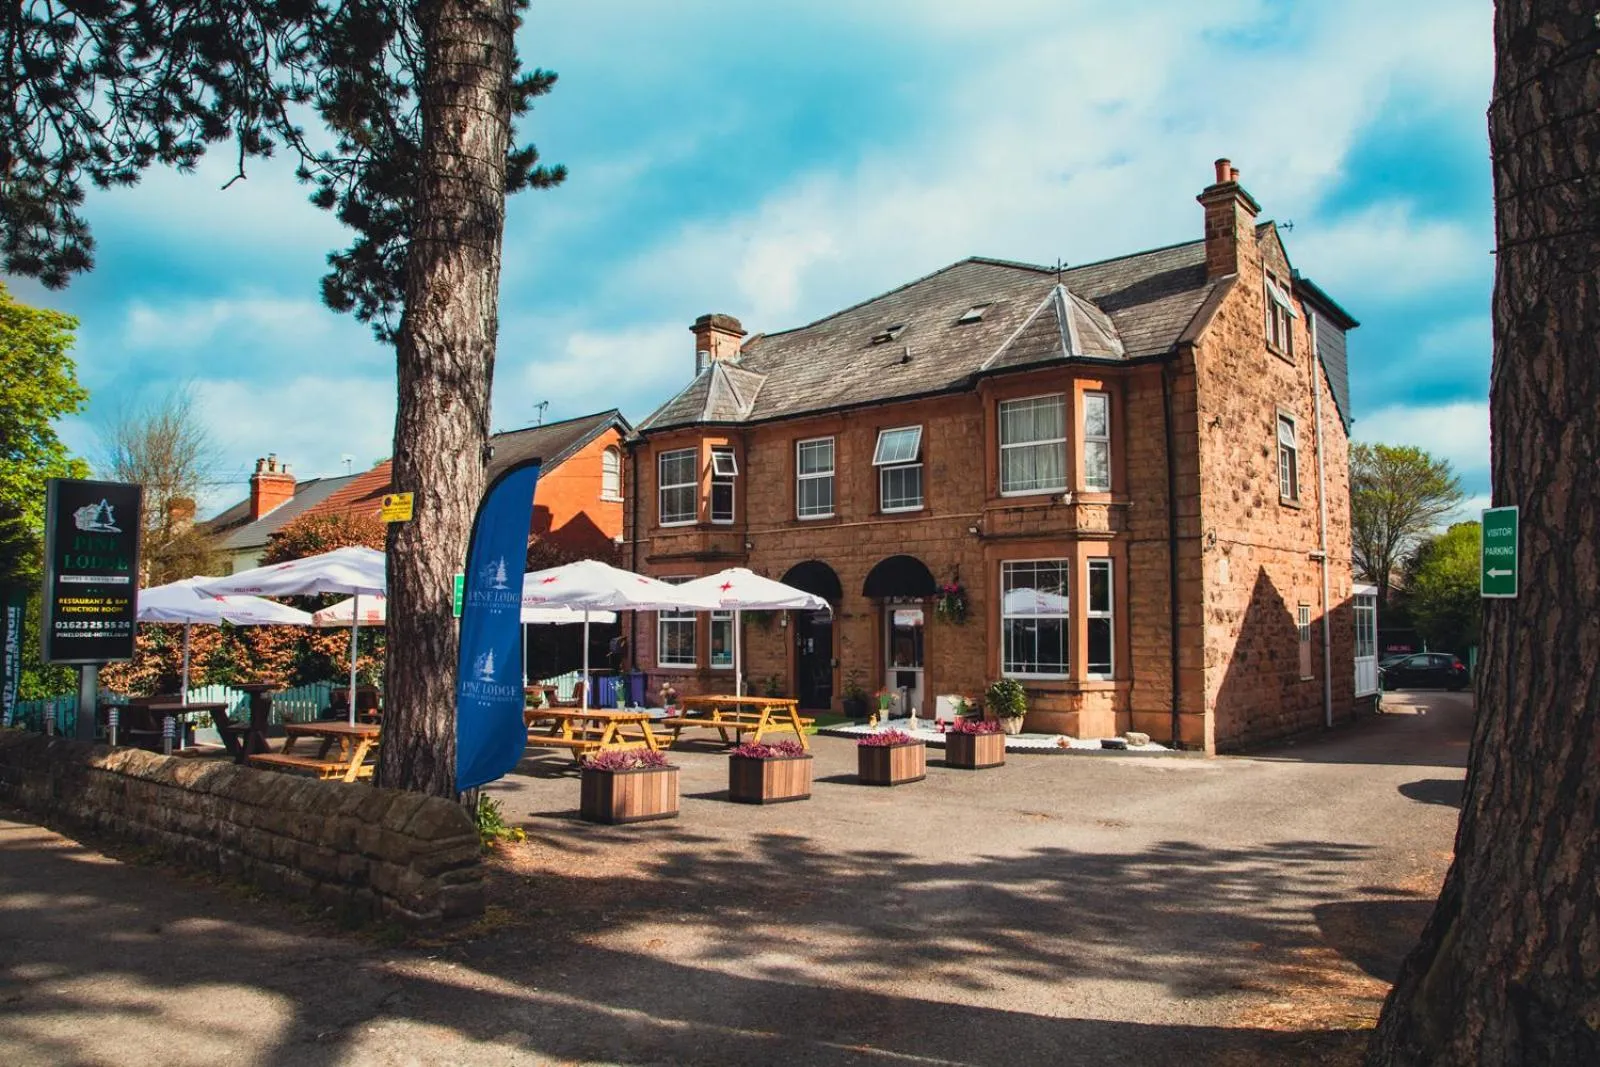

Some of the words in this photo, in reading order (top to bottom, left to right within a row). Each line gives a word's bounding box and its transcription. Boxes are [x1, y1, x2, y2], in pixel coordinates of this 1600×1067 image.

[1486, 527, 1512, 538] VISITOR
[1485, 546, 1514, 556] PARKING
[63, 553, 128, 570] LODGE
[58, 597, 104, 605] RESTAURANT
[106, 597, 113, 605] &
[62, 605, 100, 613] FUNCTION
[55, 621, 89, 630] 01623
[90, 621, 103, 630] 25
[104, 621, 116, 630] 55
[482, 682, 517, 697] LODGE
